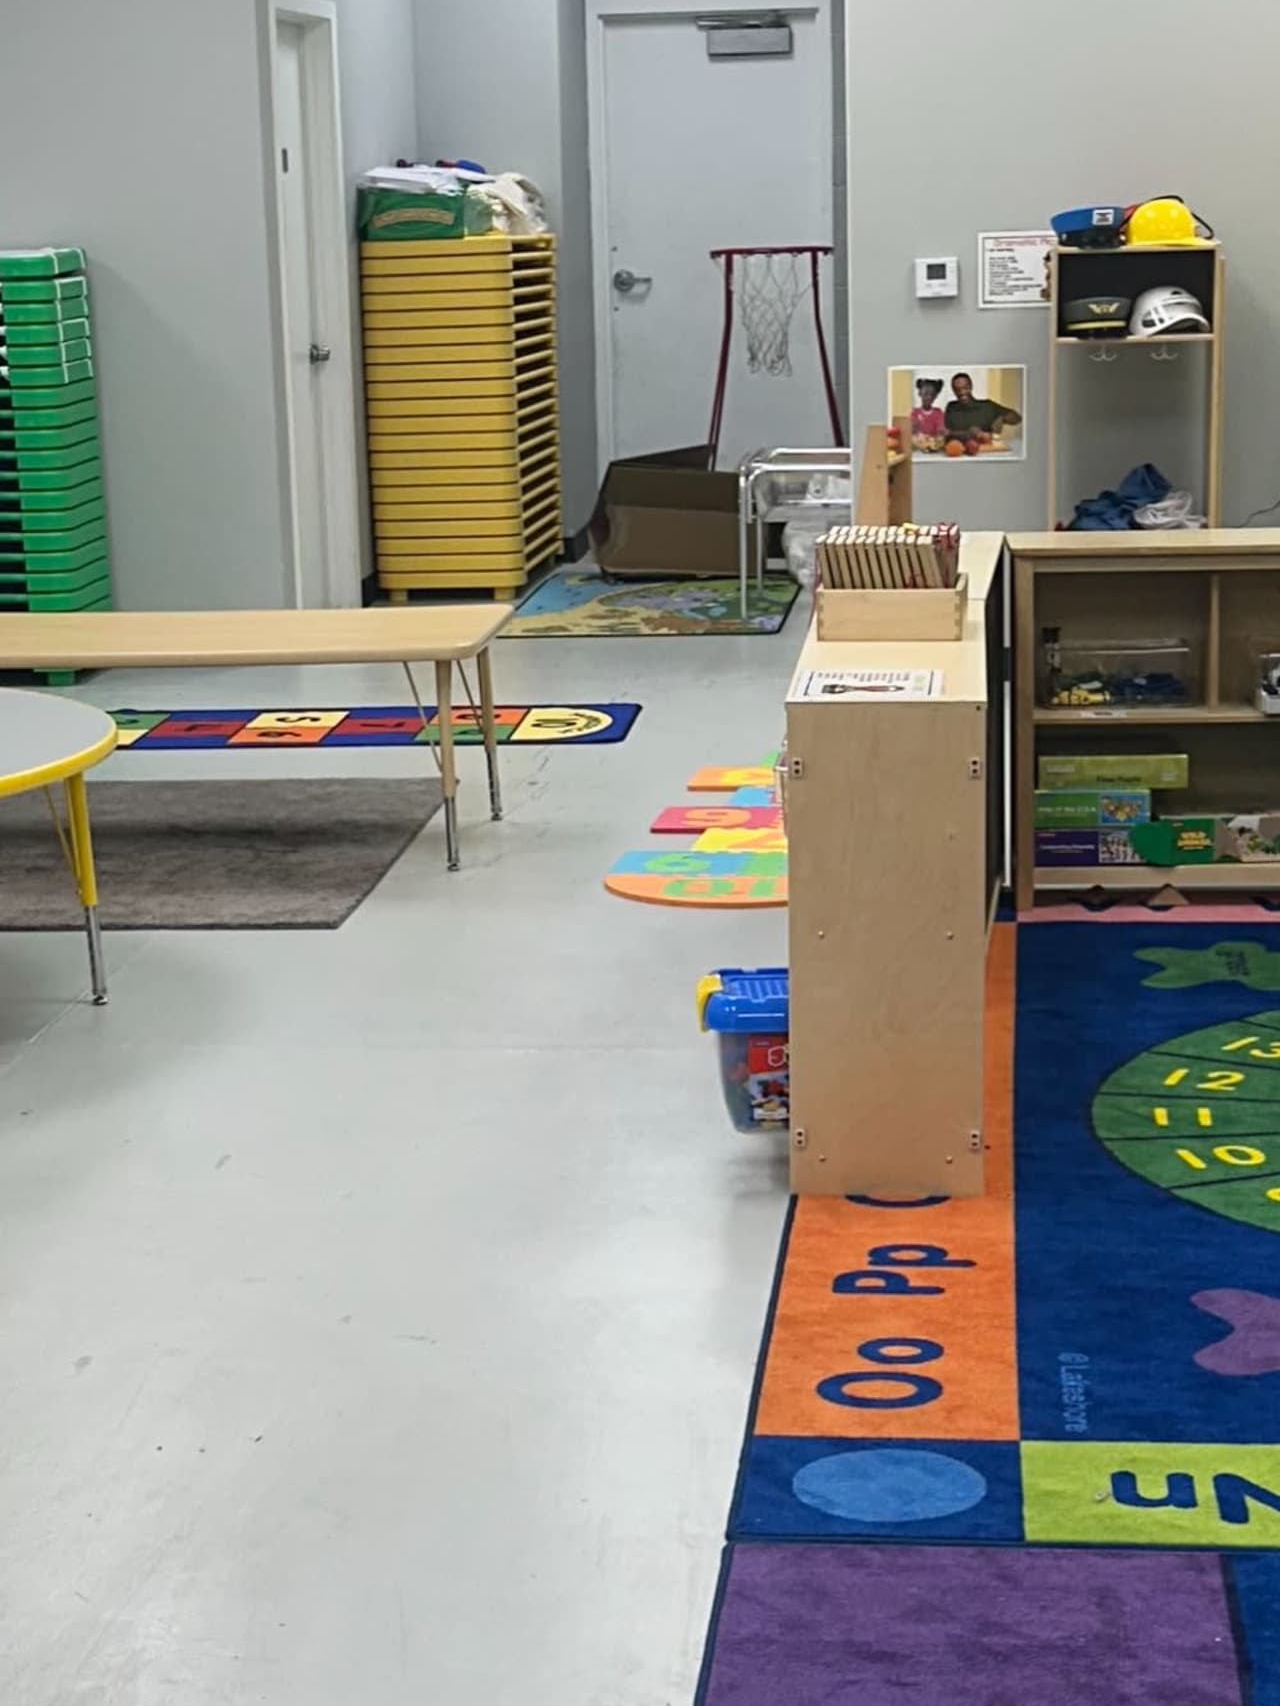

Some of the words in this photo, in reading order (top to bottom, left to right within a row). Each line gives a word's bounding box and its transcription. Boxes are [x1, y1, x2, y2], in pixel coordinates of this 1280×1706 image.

[1164, 1068, 1245, 1091] 12
[1152, 1107, 1213, 1127] 11
[1176, 1144, 1267, 1170] 10
[831, 1243, 977, 1298] Pp
[815, 1337, 945, 1409] Oo
